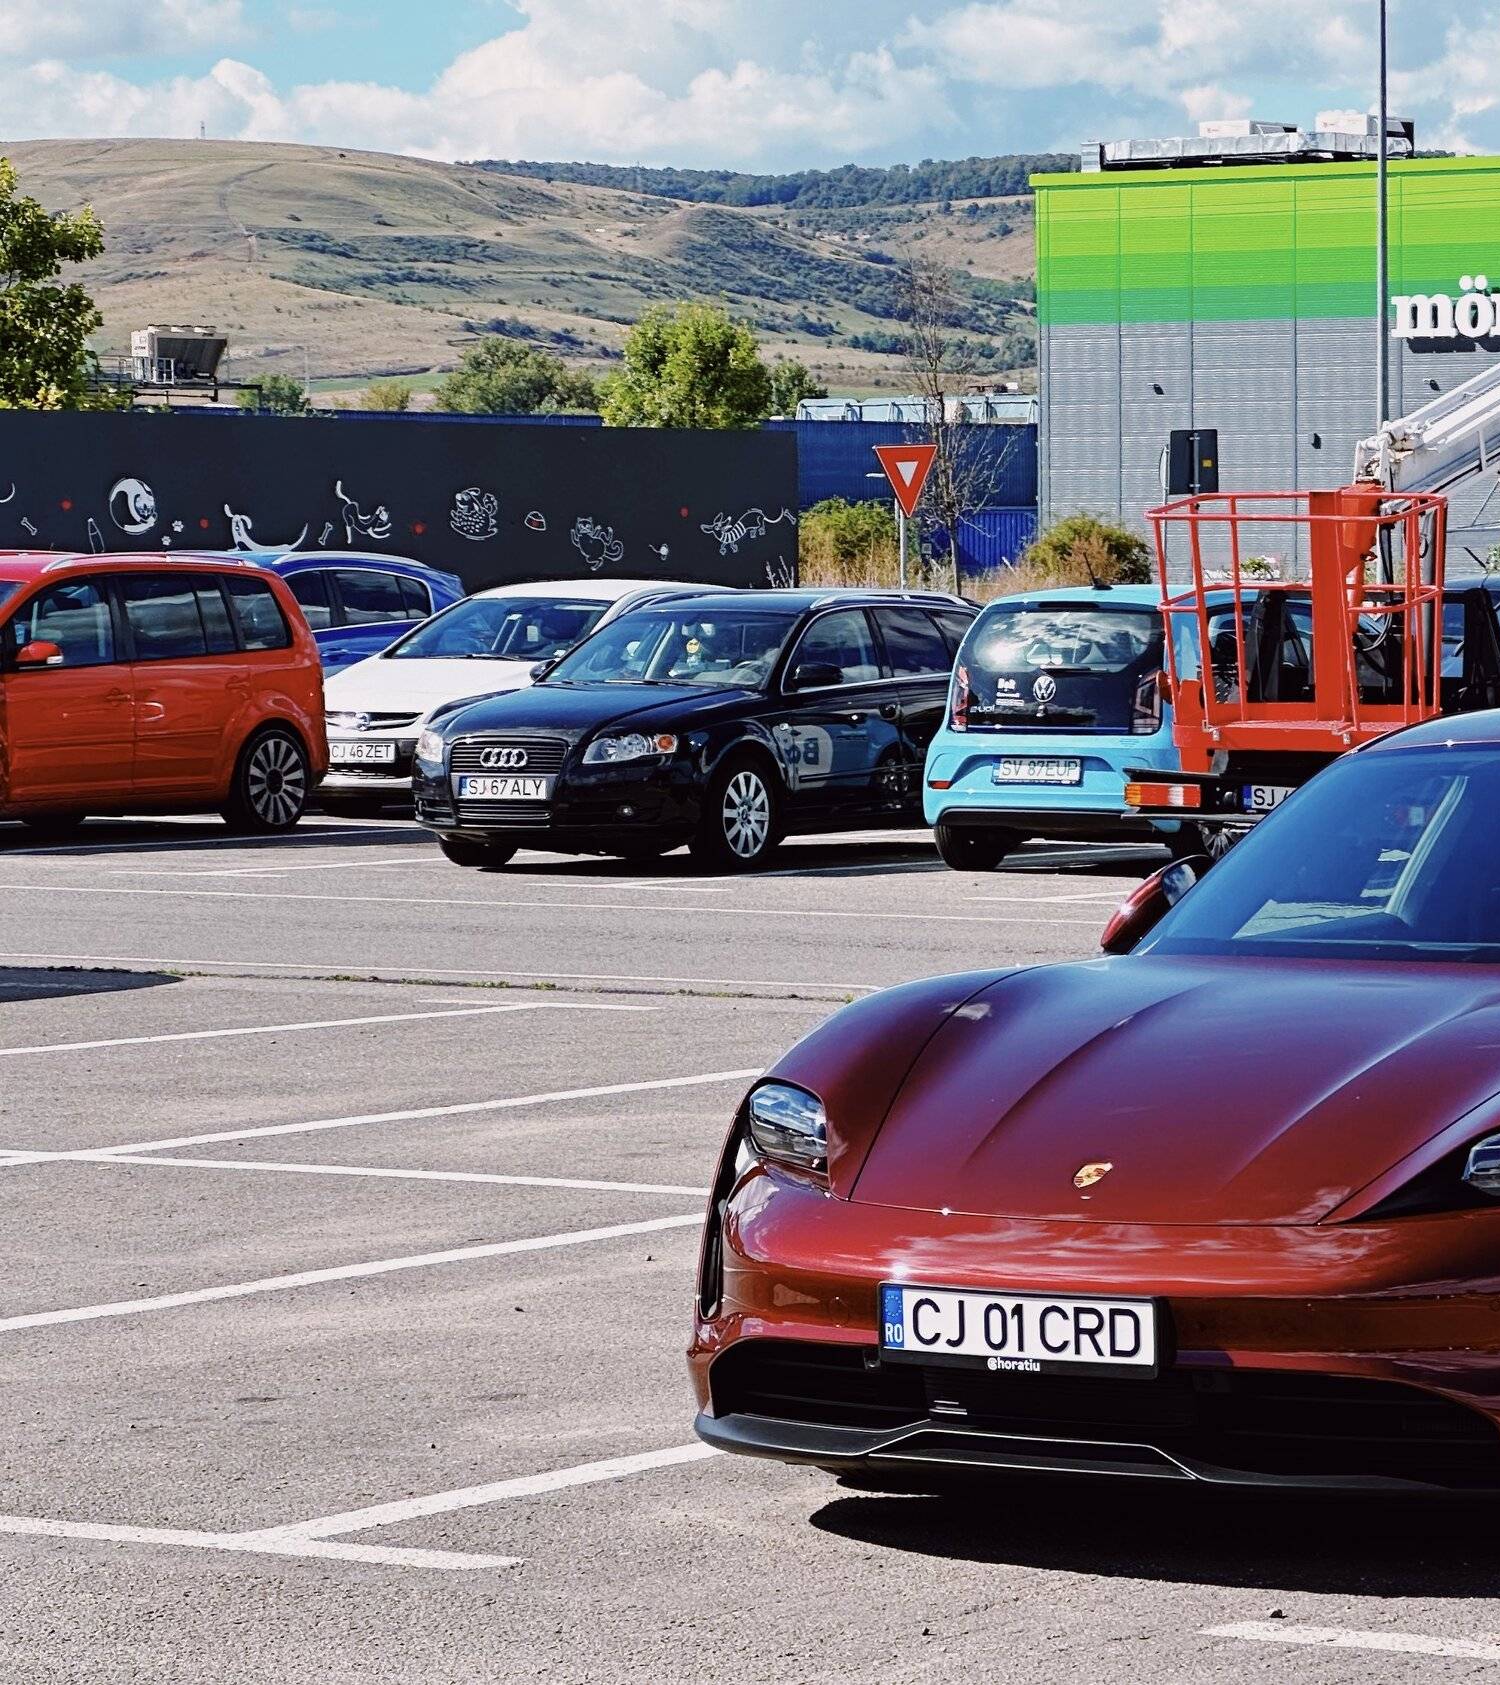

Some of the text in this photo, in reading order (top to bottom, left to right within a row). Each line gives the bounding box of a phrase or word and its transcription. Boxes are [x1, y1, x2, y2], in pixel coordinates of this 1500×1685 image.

[331, 745, 346, 758] CJ
[1001, 760, 1023, 776] SV
[469, 779, 486, 795] SJ
[884, 1297, 1142, 1358] RO CJ 01 CRD
[986, 1356, 1041, 1373] @horatiu
